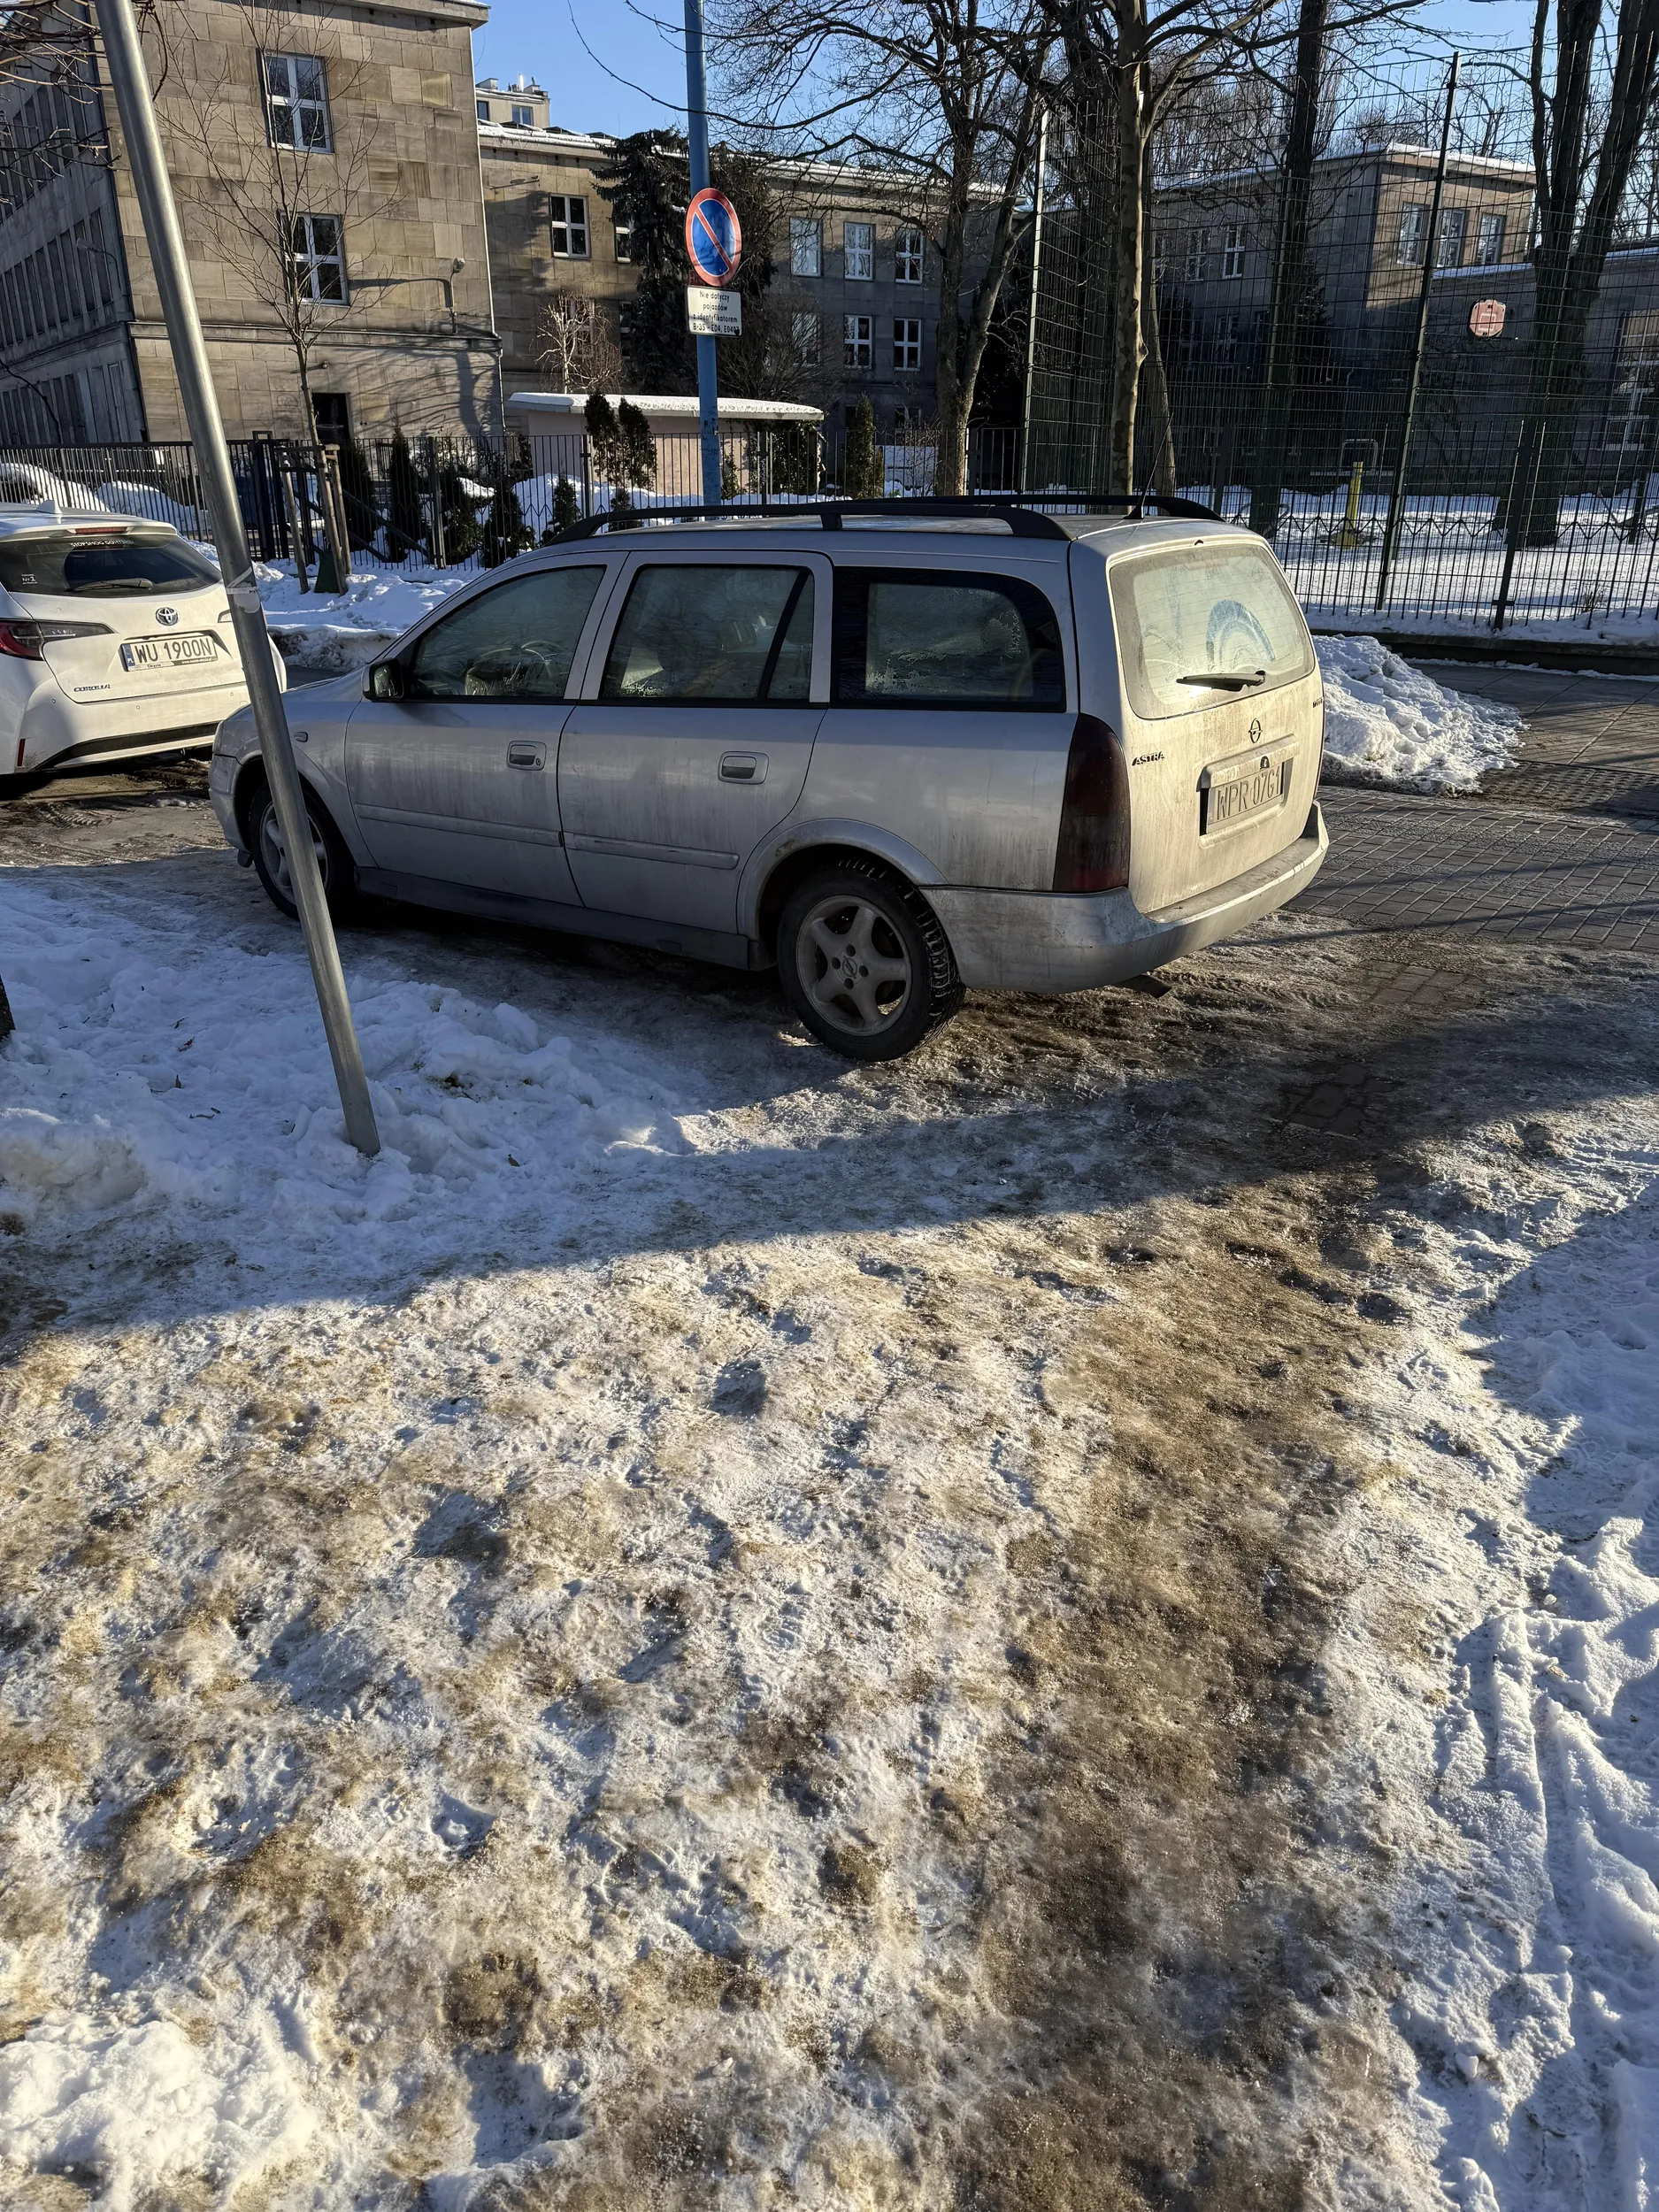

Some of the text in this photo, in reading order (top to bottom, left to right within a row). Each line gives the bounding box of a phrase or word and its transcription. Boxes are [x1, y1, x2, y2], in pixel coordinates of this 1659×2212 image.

[699, 290, 730, 303] Nie dotyczy
[703, 302, 728, 311] pojazdów
[697, 311, 738, 323] identyfikatorem
[134, 637, 212, 664] WU 1900N
[1132, 751, 1164, 766] ASTRA
[1217, 765, 1280, 820] WPR 07G1
